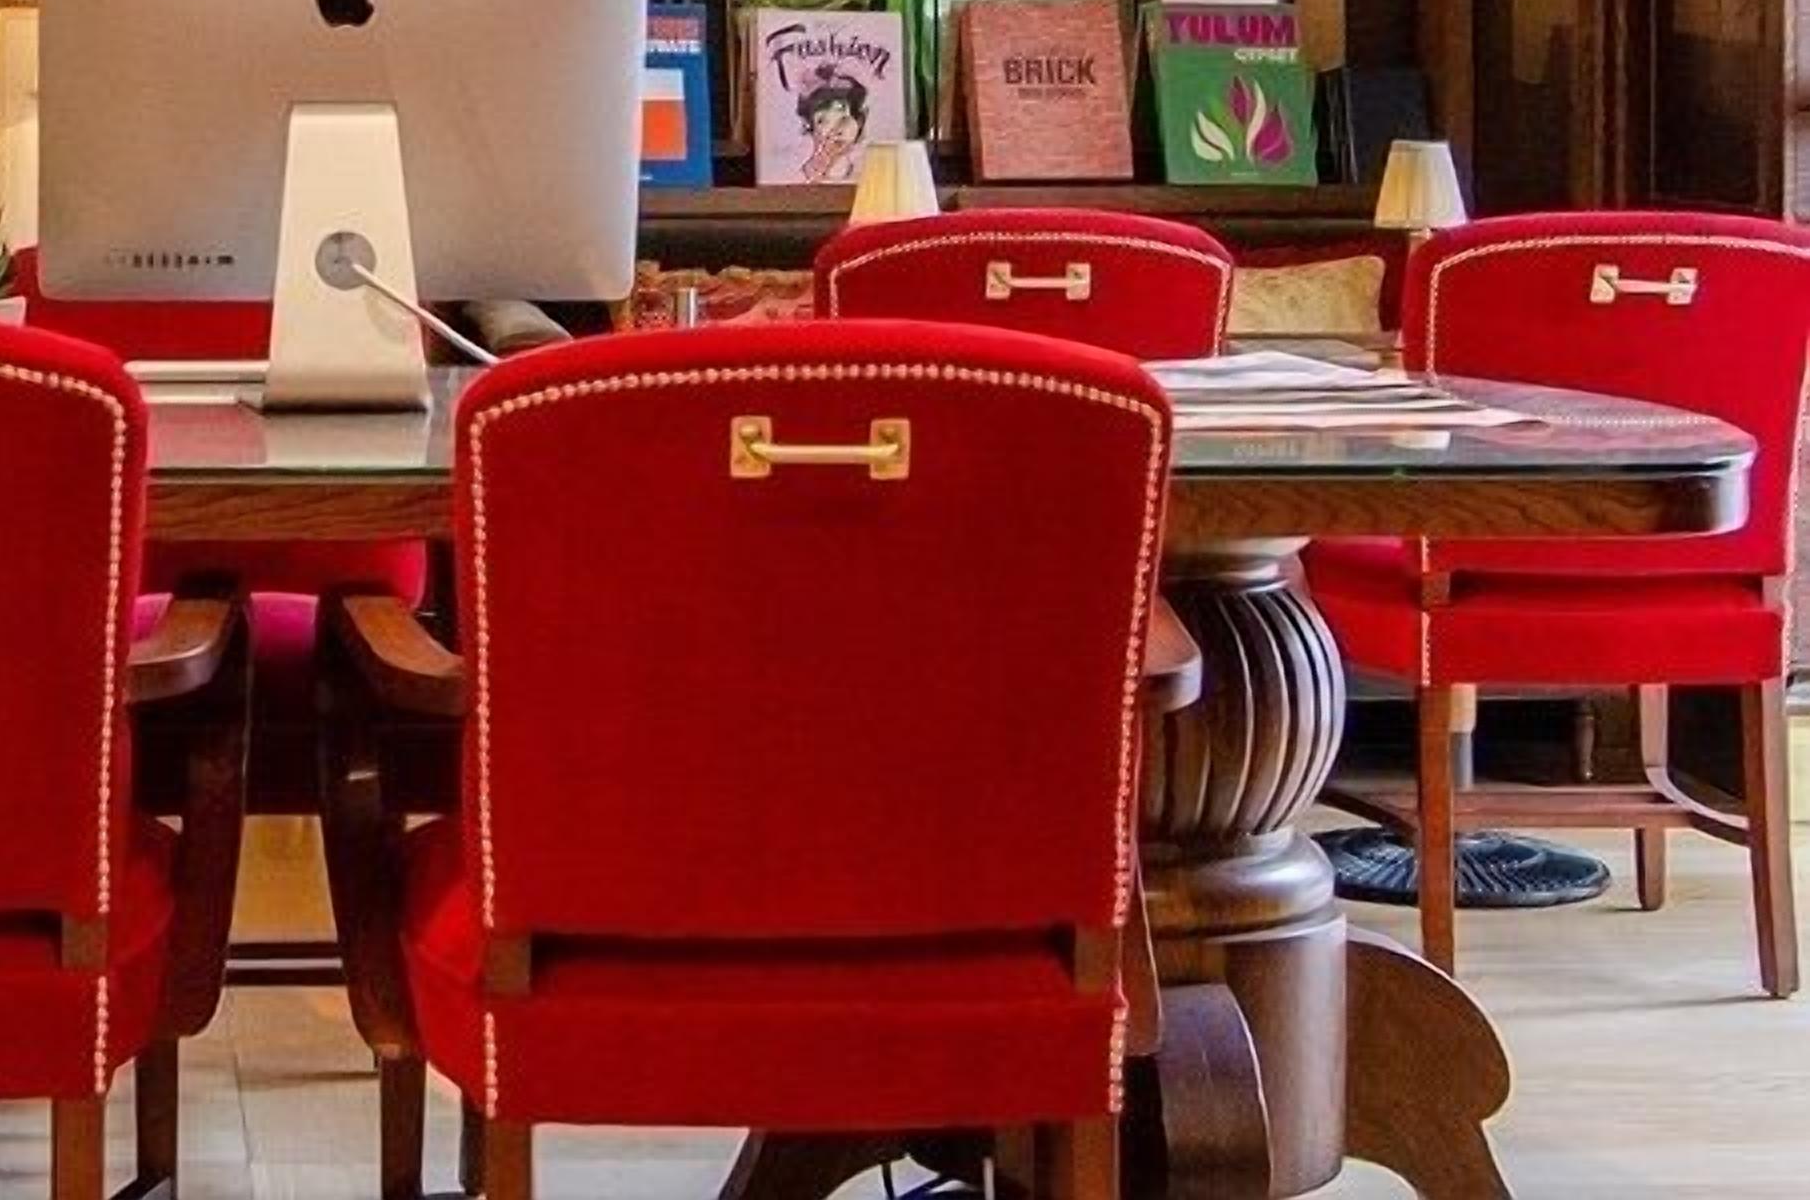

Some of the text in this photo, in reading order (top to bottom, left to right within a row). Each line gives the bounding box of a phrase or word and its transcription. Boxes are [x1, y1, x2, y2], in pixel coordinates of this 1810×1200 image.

[1167, 13, 1297, 45] TULUM
[766, 23, 890, 92] Fashion
[1003, 56, 1098, 85] BRICK
